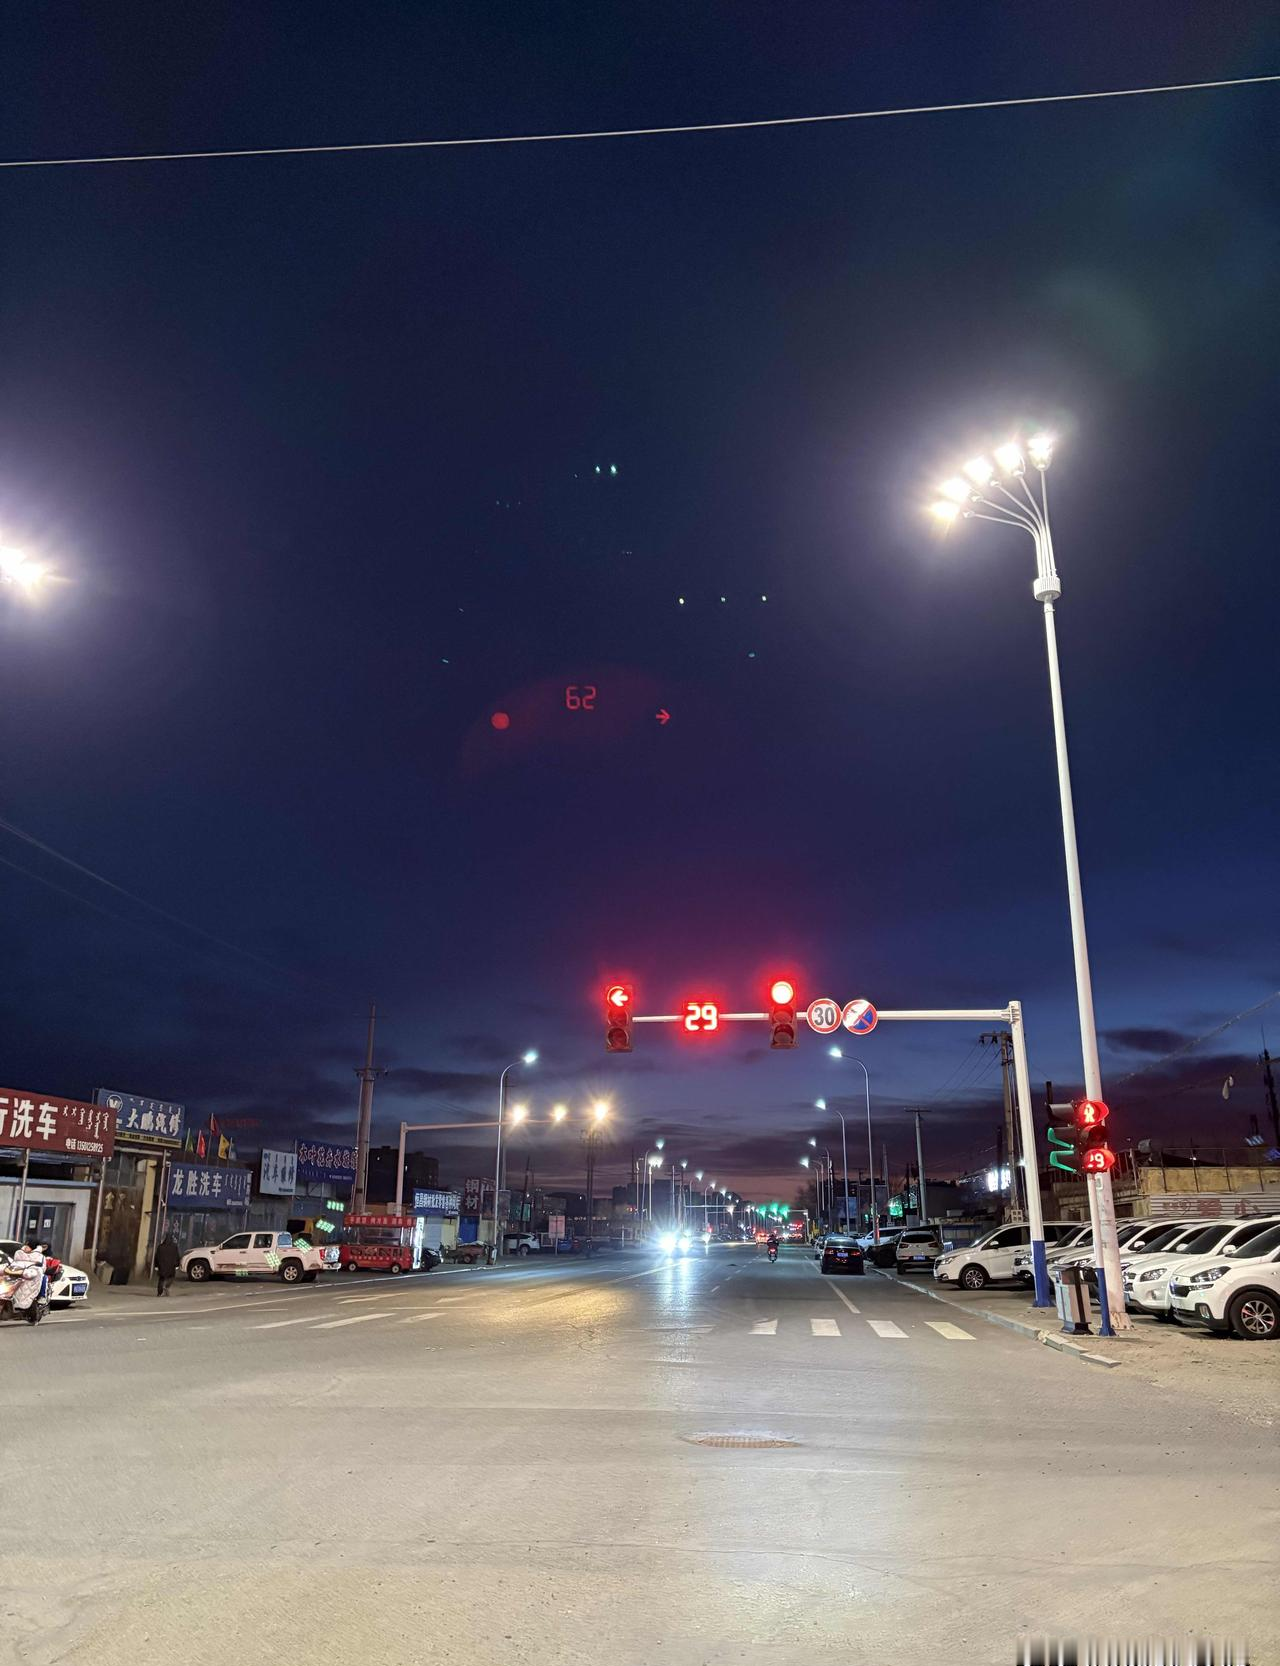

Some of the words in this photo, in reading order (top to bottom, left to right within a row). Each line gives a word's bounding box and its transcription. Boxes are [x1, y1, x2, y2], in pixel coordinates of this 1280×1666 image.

[684, 1003, 719, 1032] 29
[812, 1006, 835, 1027] 30
[171, 1168, 222, 1198] 龙胜洗车
[465, 1178, 480, 1210] 钢材
